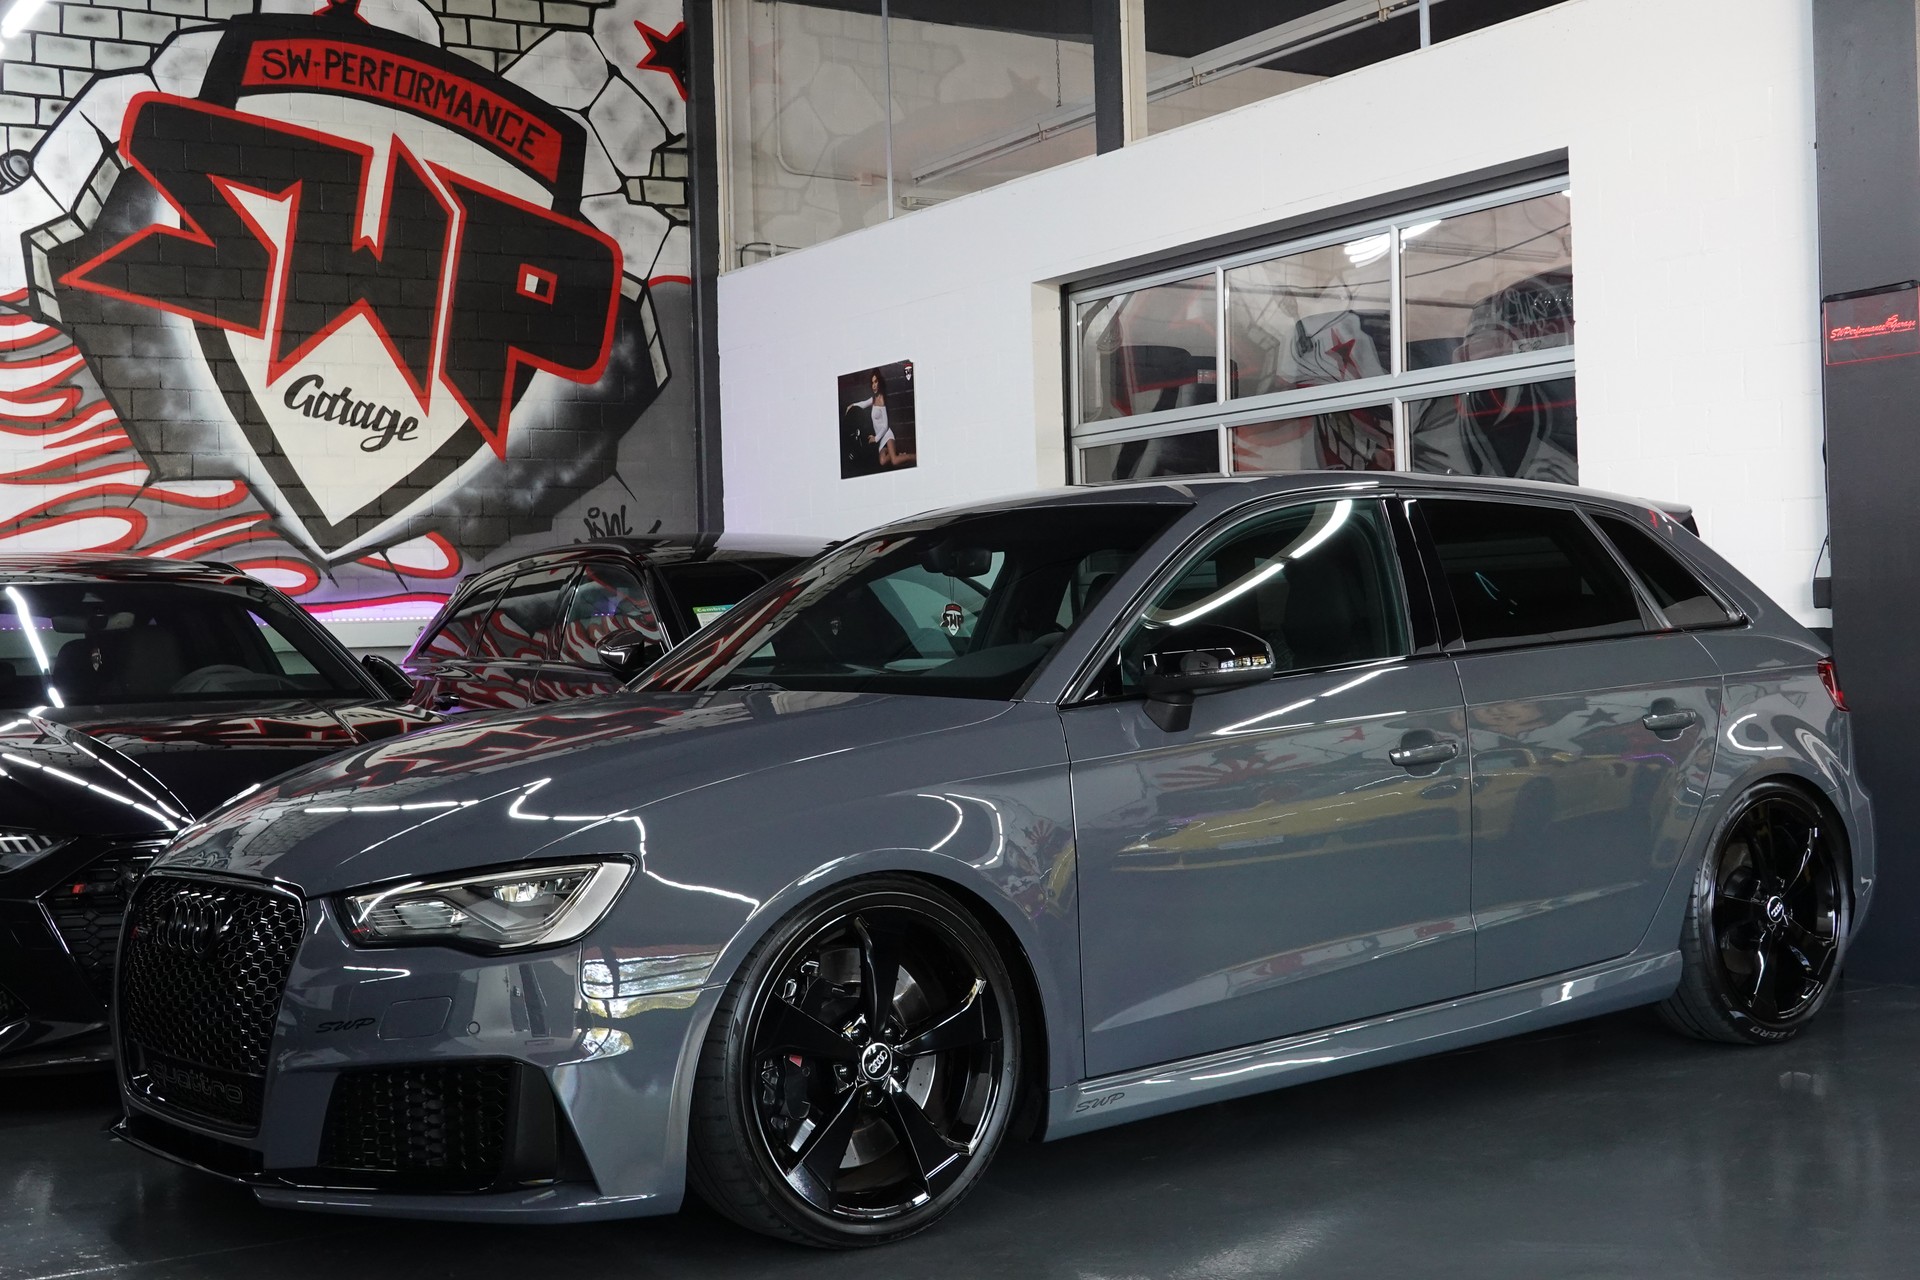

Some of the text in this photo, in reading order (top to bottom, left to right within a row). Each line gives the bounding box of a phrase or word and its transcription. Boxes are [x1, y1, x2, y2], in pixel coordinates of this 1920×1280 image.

[262, 48, 546, 160] SW-PERFORMANCE
[58, 90, 624, 462] SWP
[283, 374, 419, 452] Garage
[315, 1017, 376, 1033] SWP
[152, 1060, 243, 1104] quattro
[1075, 1092, 1125, 1113] SWP
